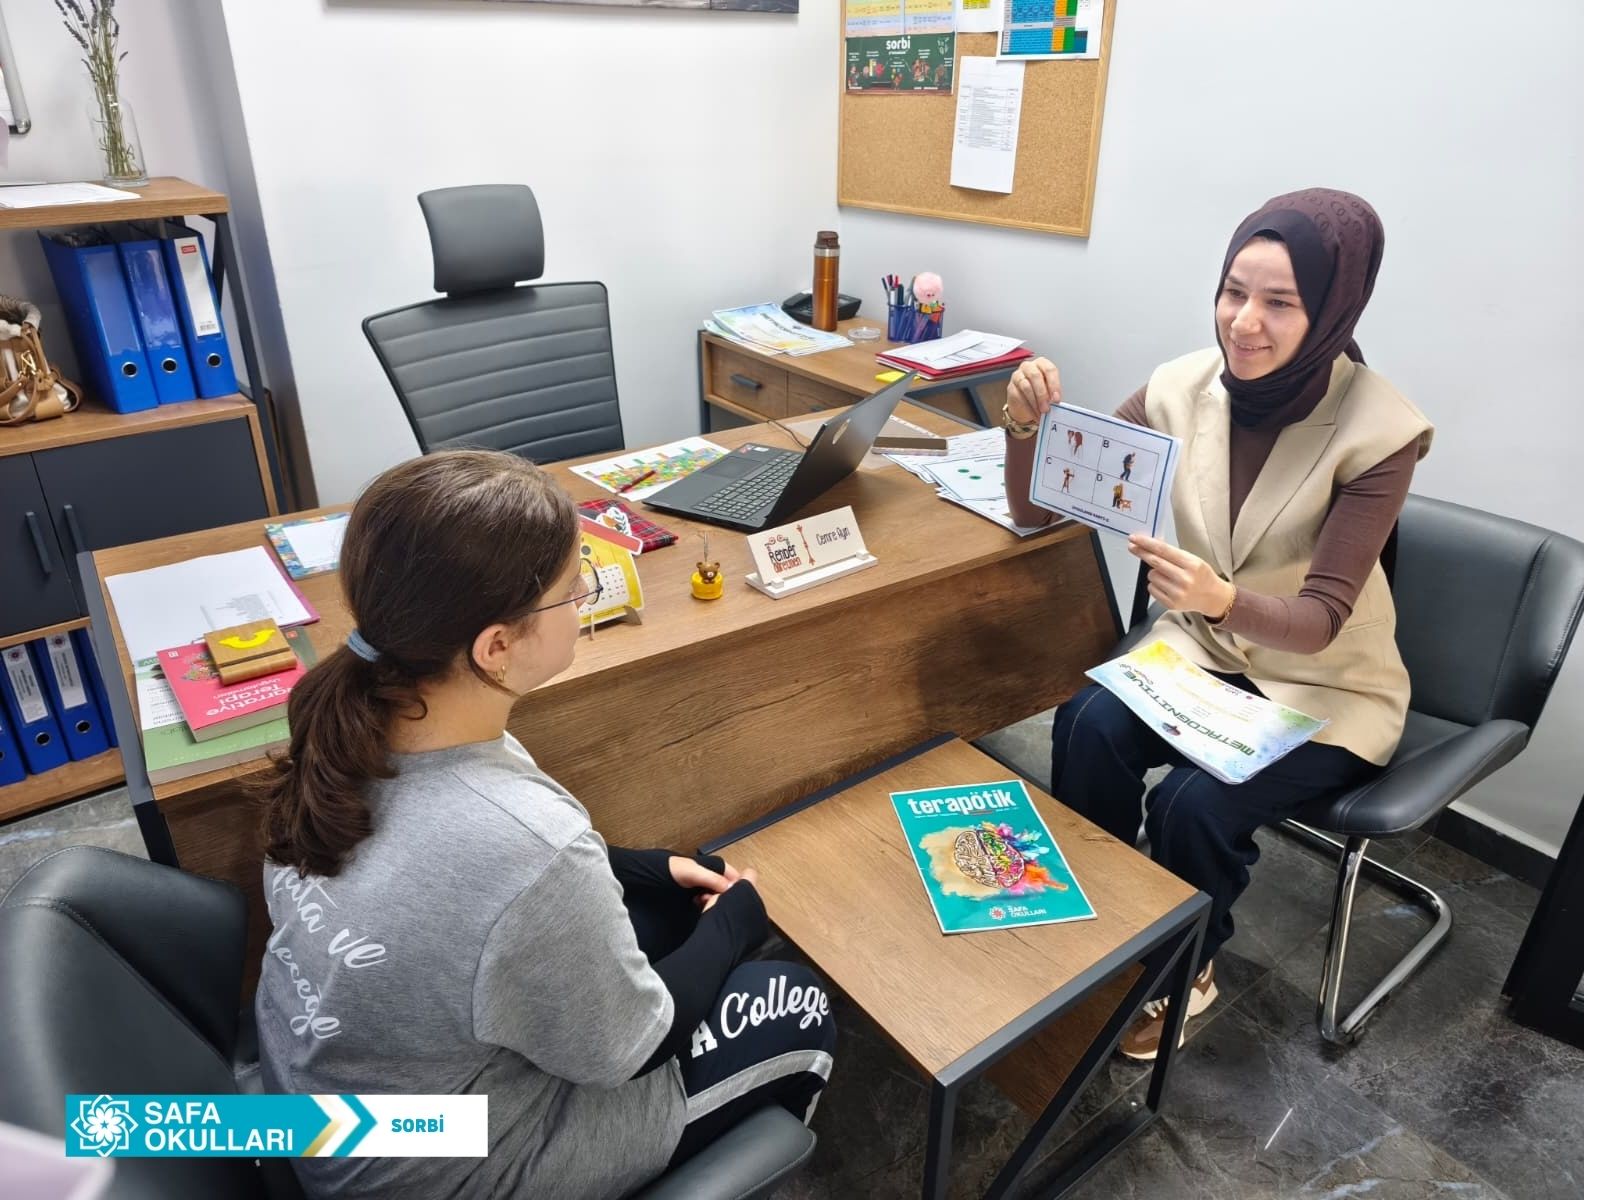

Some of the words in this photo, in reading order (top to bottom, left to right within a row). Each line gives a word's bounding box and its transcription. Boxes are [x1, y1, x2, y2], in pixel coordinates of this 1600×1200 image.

[886, 36, 910, 50] sorbi
[1051, 423, 1058, 432] A
[1102, 440, 1110, 449] B
[1046, 457, 1052, 465] C
[1096, 473, 1103, 482] D
[206, 688, 292, 716] arrative
[219, 684, 281, 706] Terapi
[1122, 669, 1256, 757] METACOGNITIVE
[907, 788, 1016, 816] terapötik
[328, 928, 388, 969] ve
[720, 975, 830, 1039] College
